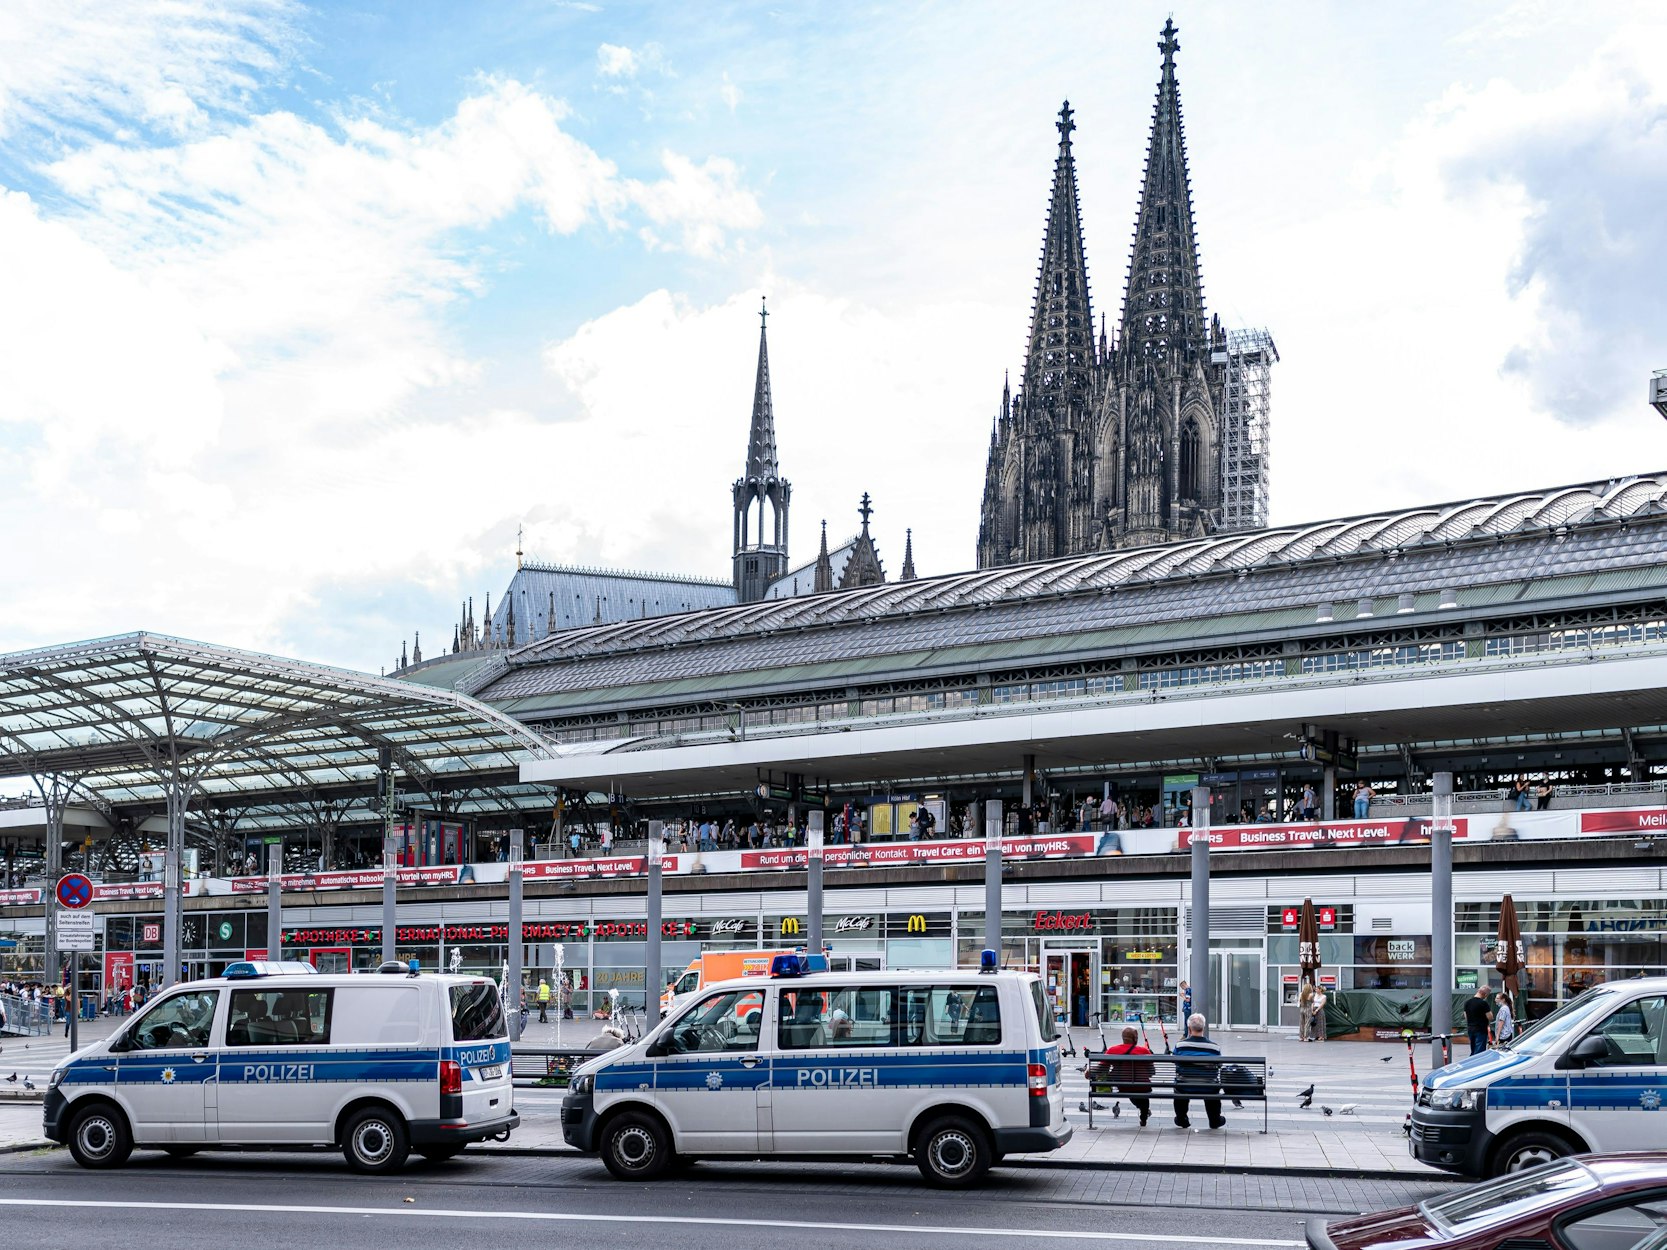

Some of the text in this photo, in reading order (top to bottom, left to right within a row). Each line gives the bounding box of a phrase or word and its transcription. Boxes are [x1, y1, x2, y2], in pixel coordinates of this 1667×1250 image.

[1639, 813, 1667, 826] Meil
[1240, 832, 1286, 843] Business
[1288, 829, 1324, 841] Travel.
[1328, 829, 1354, 840] Next
[1357, 826, 1390, 838] Level.
[760, 854, 779, 864] Rund
[795, 853, 807, 863] die
[825, 850, 872, 862] persönlicher
[875, 849, 908, 859] Kontakt.
[913, 847, 939, 857] Travel
[941, 846, 963, 856] Care:
[967, 845, 980, 855] ein
[1015, 844, 1032, 853] von
[1034, 841, 1070, 853] myHRS.
[545, 865, 573, 874] Business
[574, 863, 595, 873] Travel.
[597, 862, 613, 872] Next
[614, 861, 633, 871] Level.
[288, 879, 317, 887] mitnehmen.
[320, 876, 358, 885] Automatisches
[401, 872, 419, 881] Vorteil
[432, 871, 454, 881] myHRS.
[100, 888, 119, 896] Business
[145, 927, 157, 939] DB
[221, 924, 230, 939] S
[294, 922, 678, 942] APOTHEKE IERNATIONAL PHRMACY APOTHKE
[1389, 942, 1413, 951] back
[1387, 952, 1415, 960] WERK
[610, 970, 644, 982] JAHRE
[460, 1049, 490, 1066] POLIZEI
[244, 1064, 315, 1081] POLIZEI
[797, 1068, 879, 1086] POLIZEI
